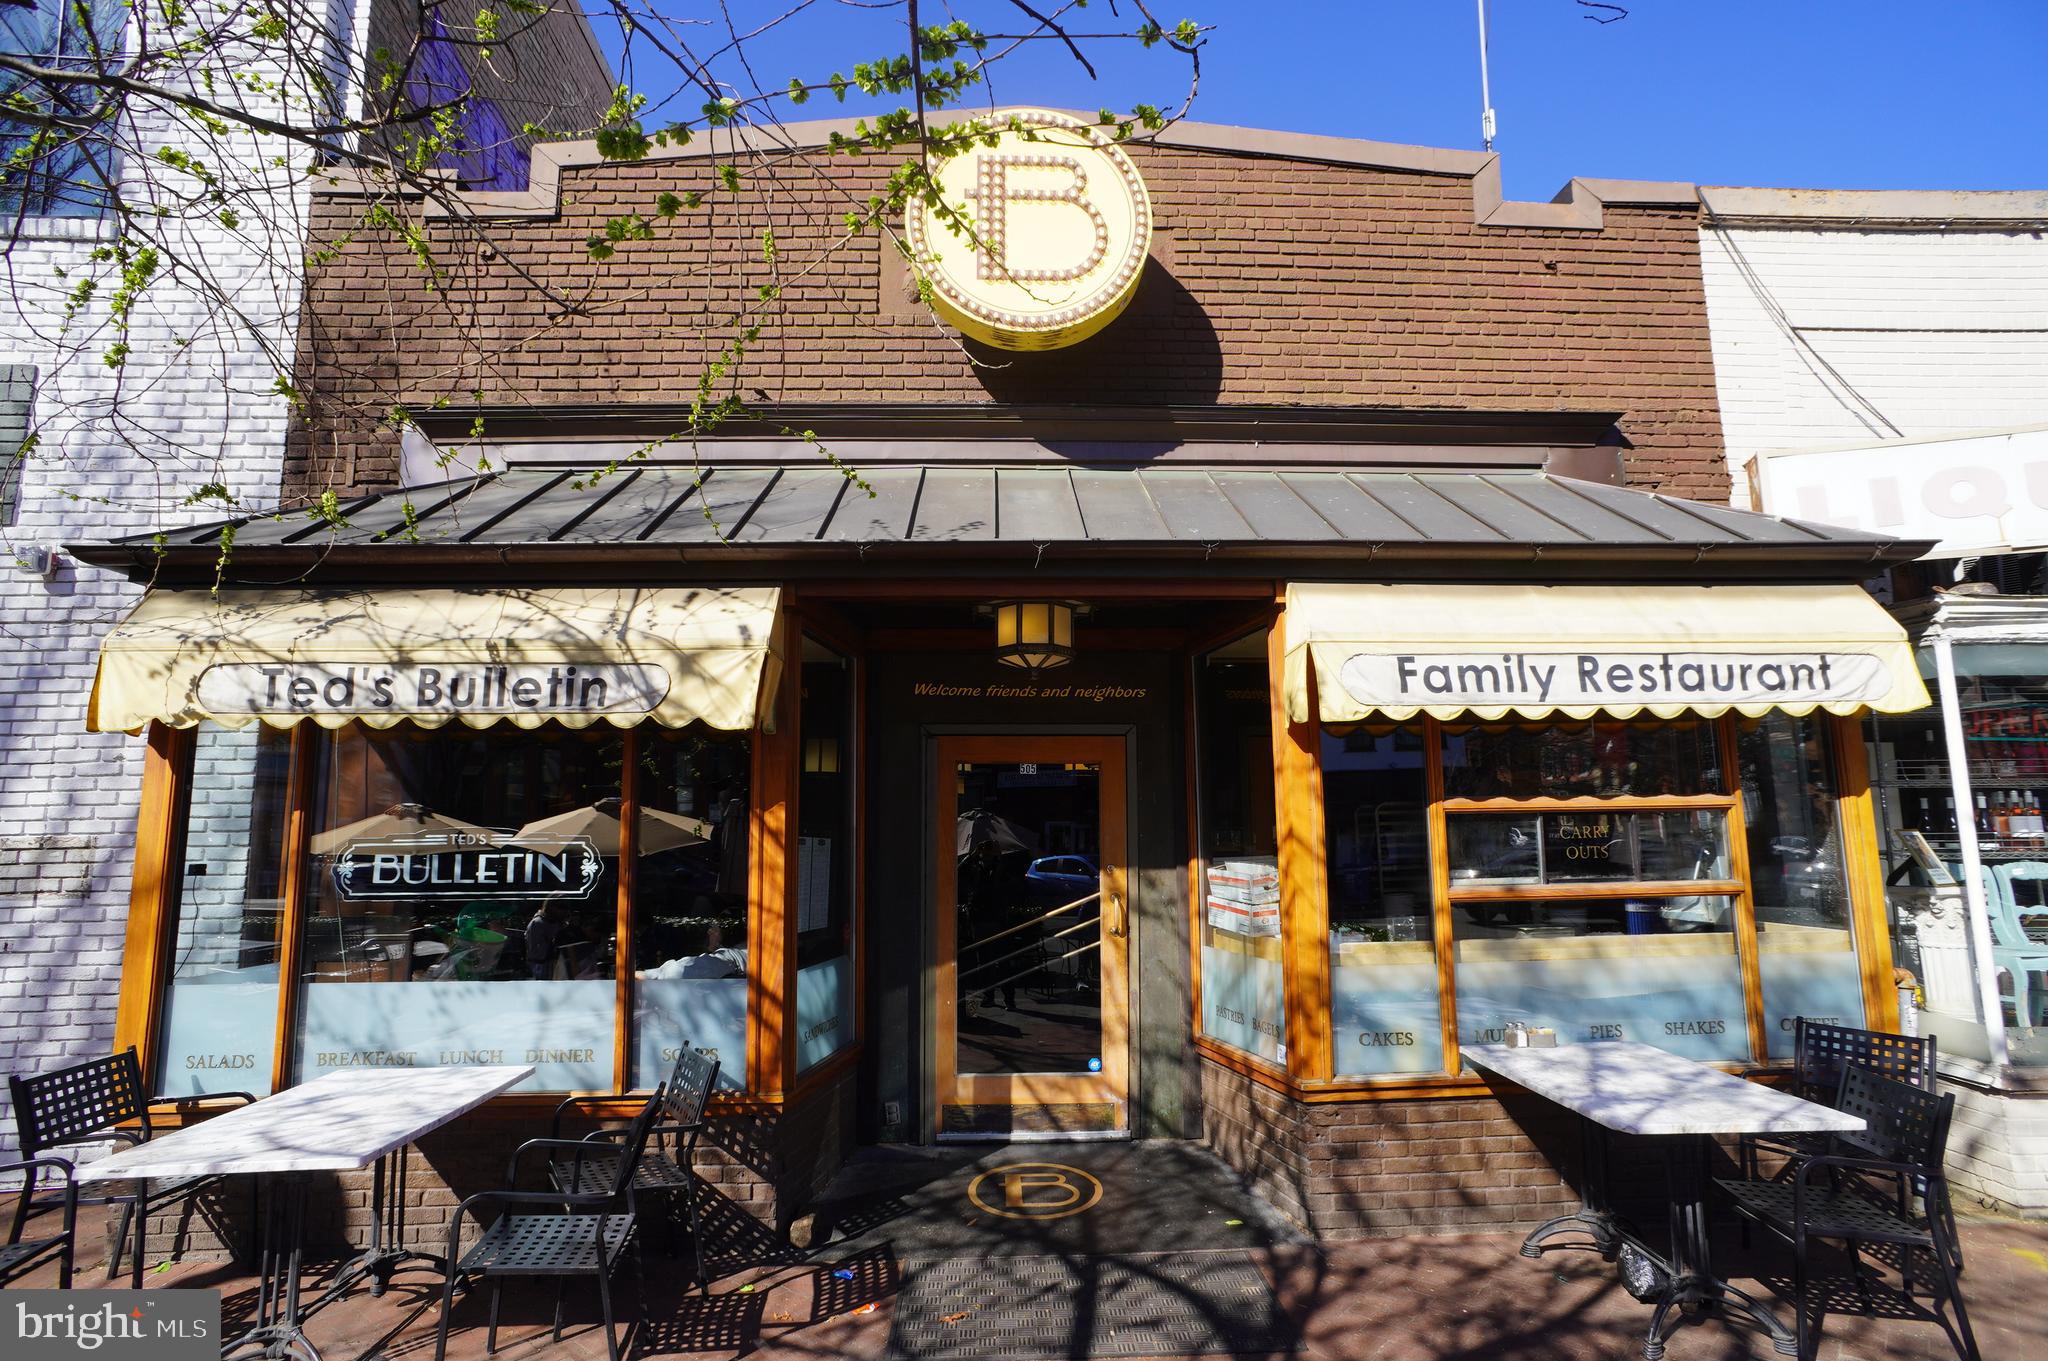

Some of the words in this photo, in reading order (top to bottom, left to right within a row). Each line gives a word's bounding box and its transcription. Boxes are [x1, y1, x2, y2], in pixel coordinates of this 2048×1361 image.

[965, 154, 1109, 281] B
[1795, 459, 2048, 530] LIQ
[262, 667, 395, 708] Ted's
[416, 666, 608, 708] Bulletin
[1397, 654, 1557, 702] Family
[1578, 654, 1832, 693] Restaurant
[914, 683, 981, 696] Welcome
[985, 684, 1037, 697] friends
[1041, 685, 1072, 697] and
[1074, 685, 1147, 702] neighbors
[1020, 763, 1037, 775] 505
[449, 834, 488, 845] TED'S
[1559, 825, 1610, 840] CARRY
[1566, 845, 1609, 860] OUTS
[372, 853, 567, 885] BULLETIN
[1215, 1005, 1245, 1025] PASTRIES
[1252, 1017, 1280, 1039] BAGELS
[1589, 1024, 1623, 1039] PIES
[1664, 1020, 1726, 1036] SHAKES
[1358, 1032, 1414, 1047] CAKES
[185, 1054, 255, 1069] SALADS
[316, 1050, 418, 1067] BREAKFAST
[439, 1049, 504, 1065] LUNCH
[525, 1049, 595, 1064] DINNER
[662, 1048, 719, 1062] SOPS
[998, 1172, 1081, 1208] B
